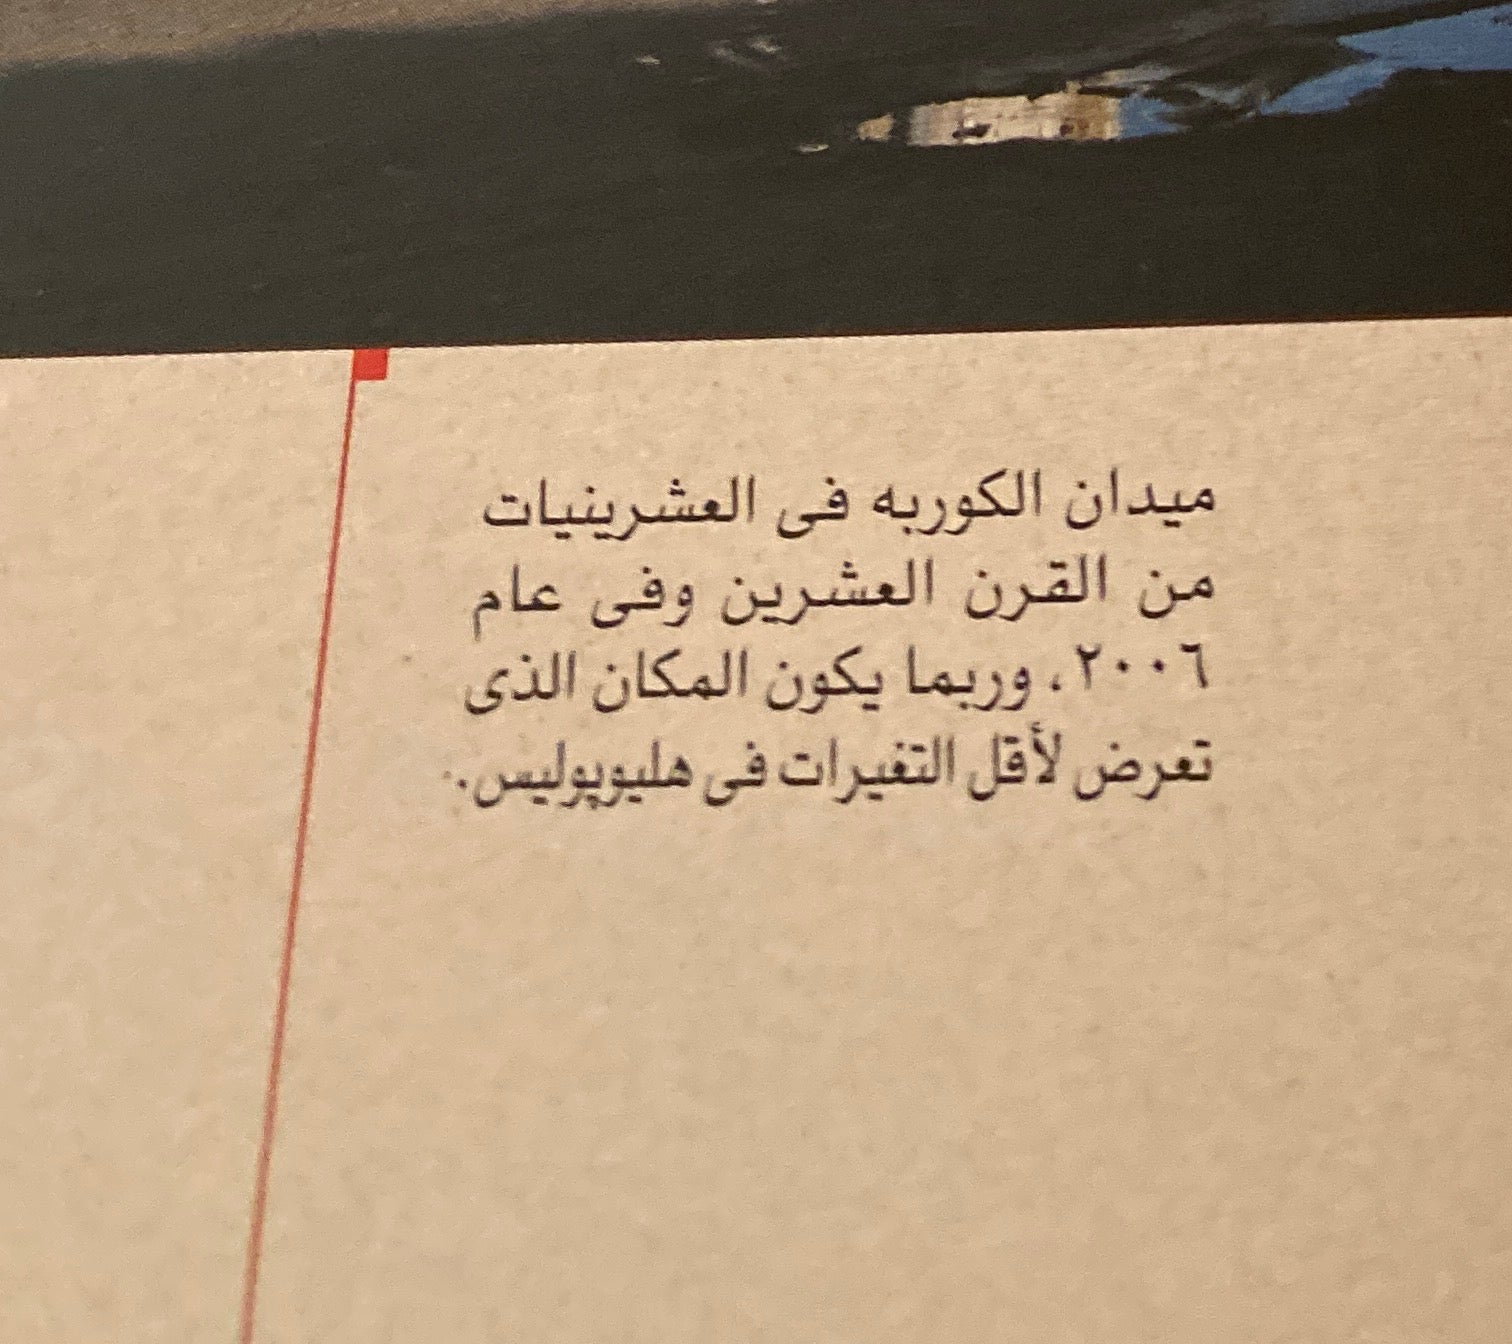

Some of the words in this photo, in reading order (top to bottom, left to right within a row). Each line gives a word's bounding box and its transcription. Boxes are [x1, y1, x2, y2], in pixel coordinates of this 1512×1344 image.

[483, 474, 755, 541] العشرينيات
[777, 487, 849, 540] فى
[873, 468, 1041, 536] الكوربه
[1065, 467, 1215, 530] ميدان
[473, 564, 562, 642] عام
[591, 565, 694, 629] وفى
[721, 558, 934, 627] العشرين
[964, 553, 1106, 623] القرن
[1139, 569, 1215, 620] من
[464, 650, 577, 715] الذى
[593, 647, 748, 714] المكان
[765, 645, 884, 716] يكون
[907, 644, 1031, 712] وربما
[703, 740, 768, 808] فى
[779, 736, 955, 806] التغيرات
[968, 717, 1062, 803] لأقل
[1073, 739, 1213, 802] تعرض
